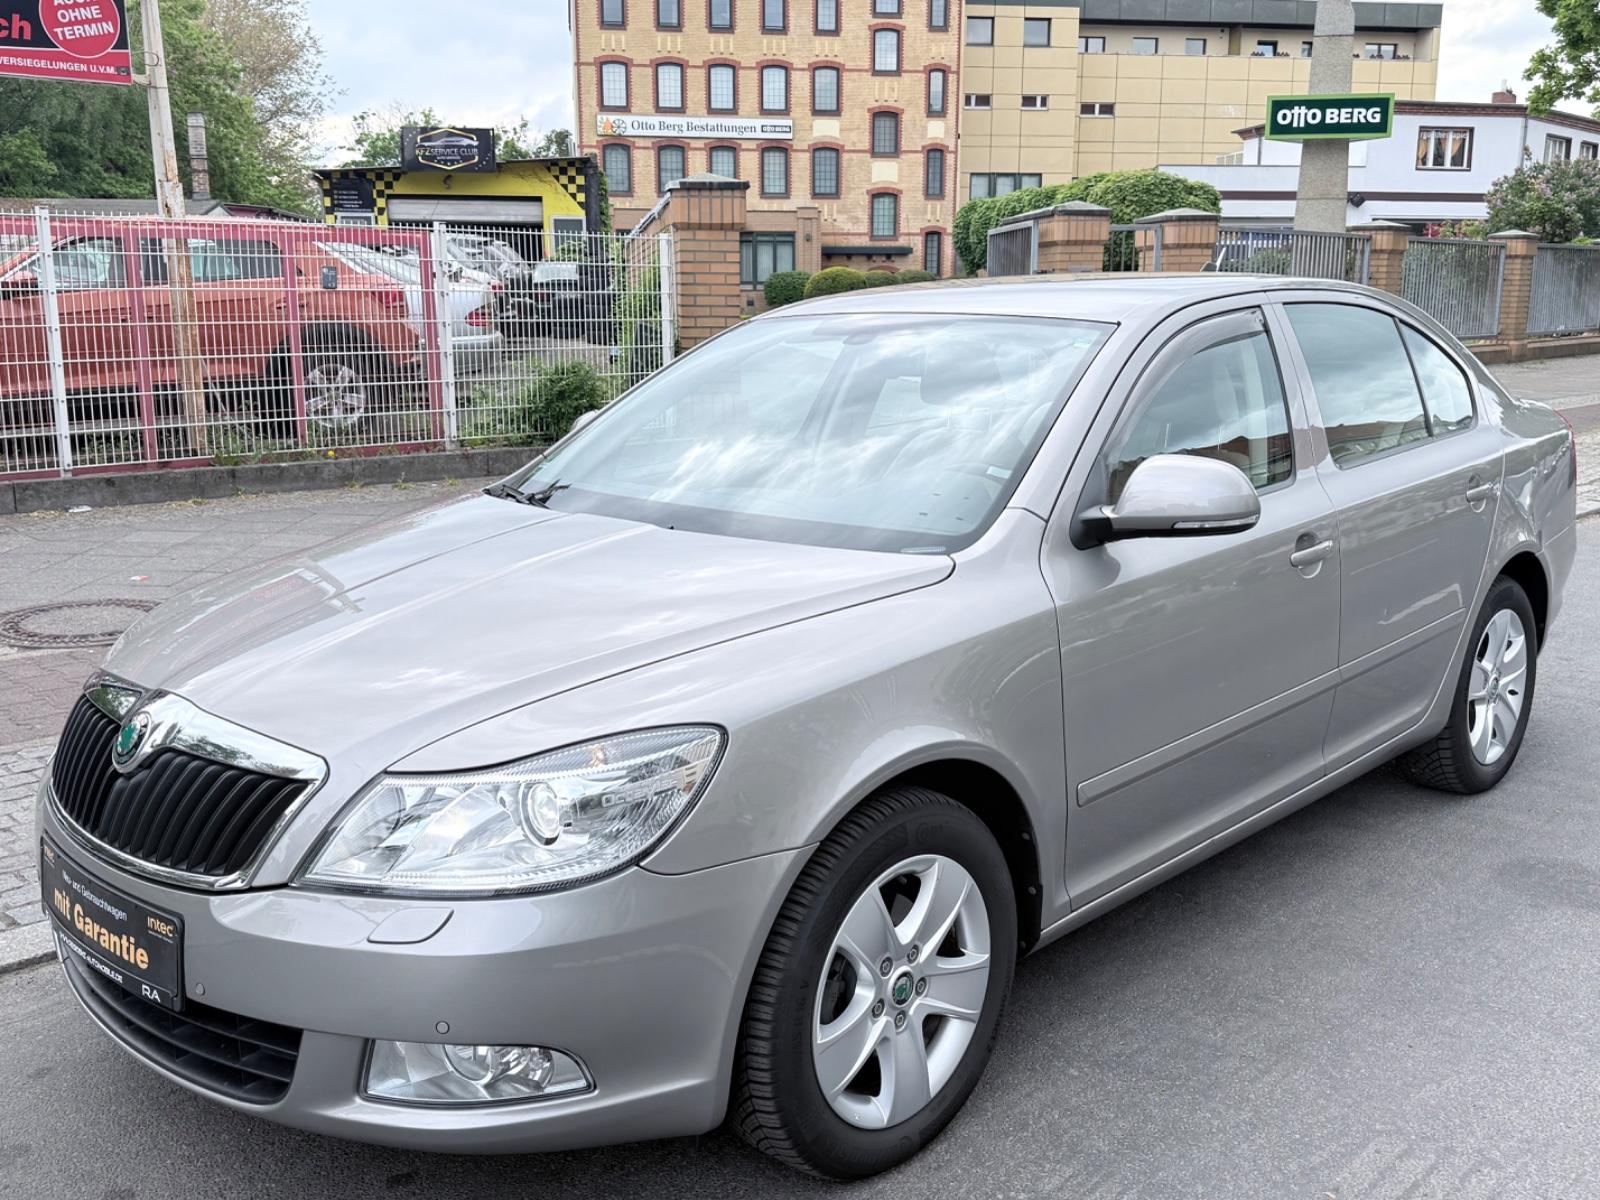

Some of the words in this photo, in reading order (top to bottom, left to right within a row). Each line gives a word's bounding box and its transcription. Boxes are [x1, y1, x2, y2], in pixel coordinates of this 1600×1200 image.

[57, 5, 102, 22] OHNE
[53, 21, 115, 40] TERMIN
[90, 64, 118, 75] U.V.M.
[1325, 107, 1381, 124] BERG
[631, 119, 656, 131] Otto
[659, 120, 684, 134] Berg
[687, 121, 757, 136] Bestattungen
[460, 148, 479, 156] CLUB
[54, 887, 71, 921] mit
[74, 903, 149, 970] Garantie
